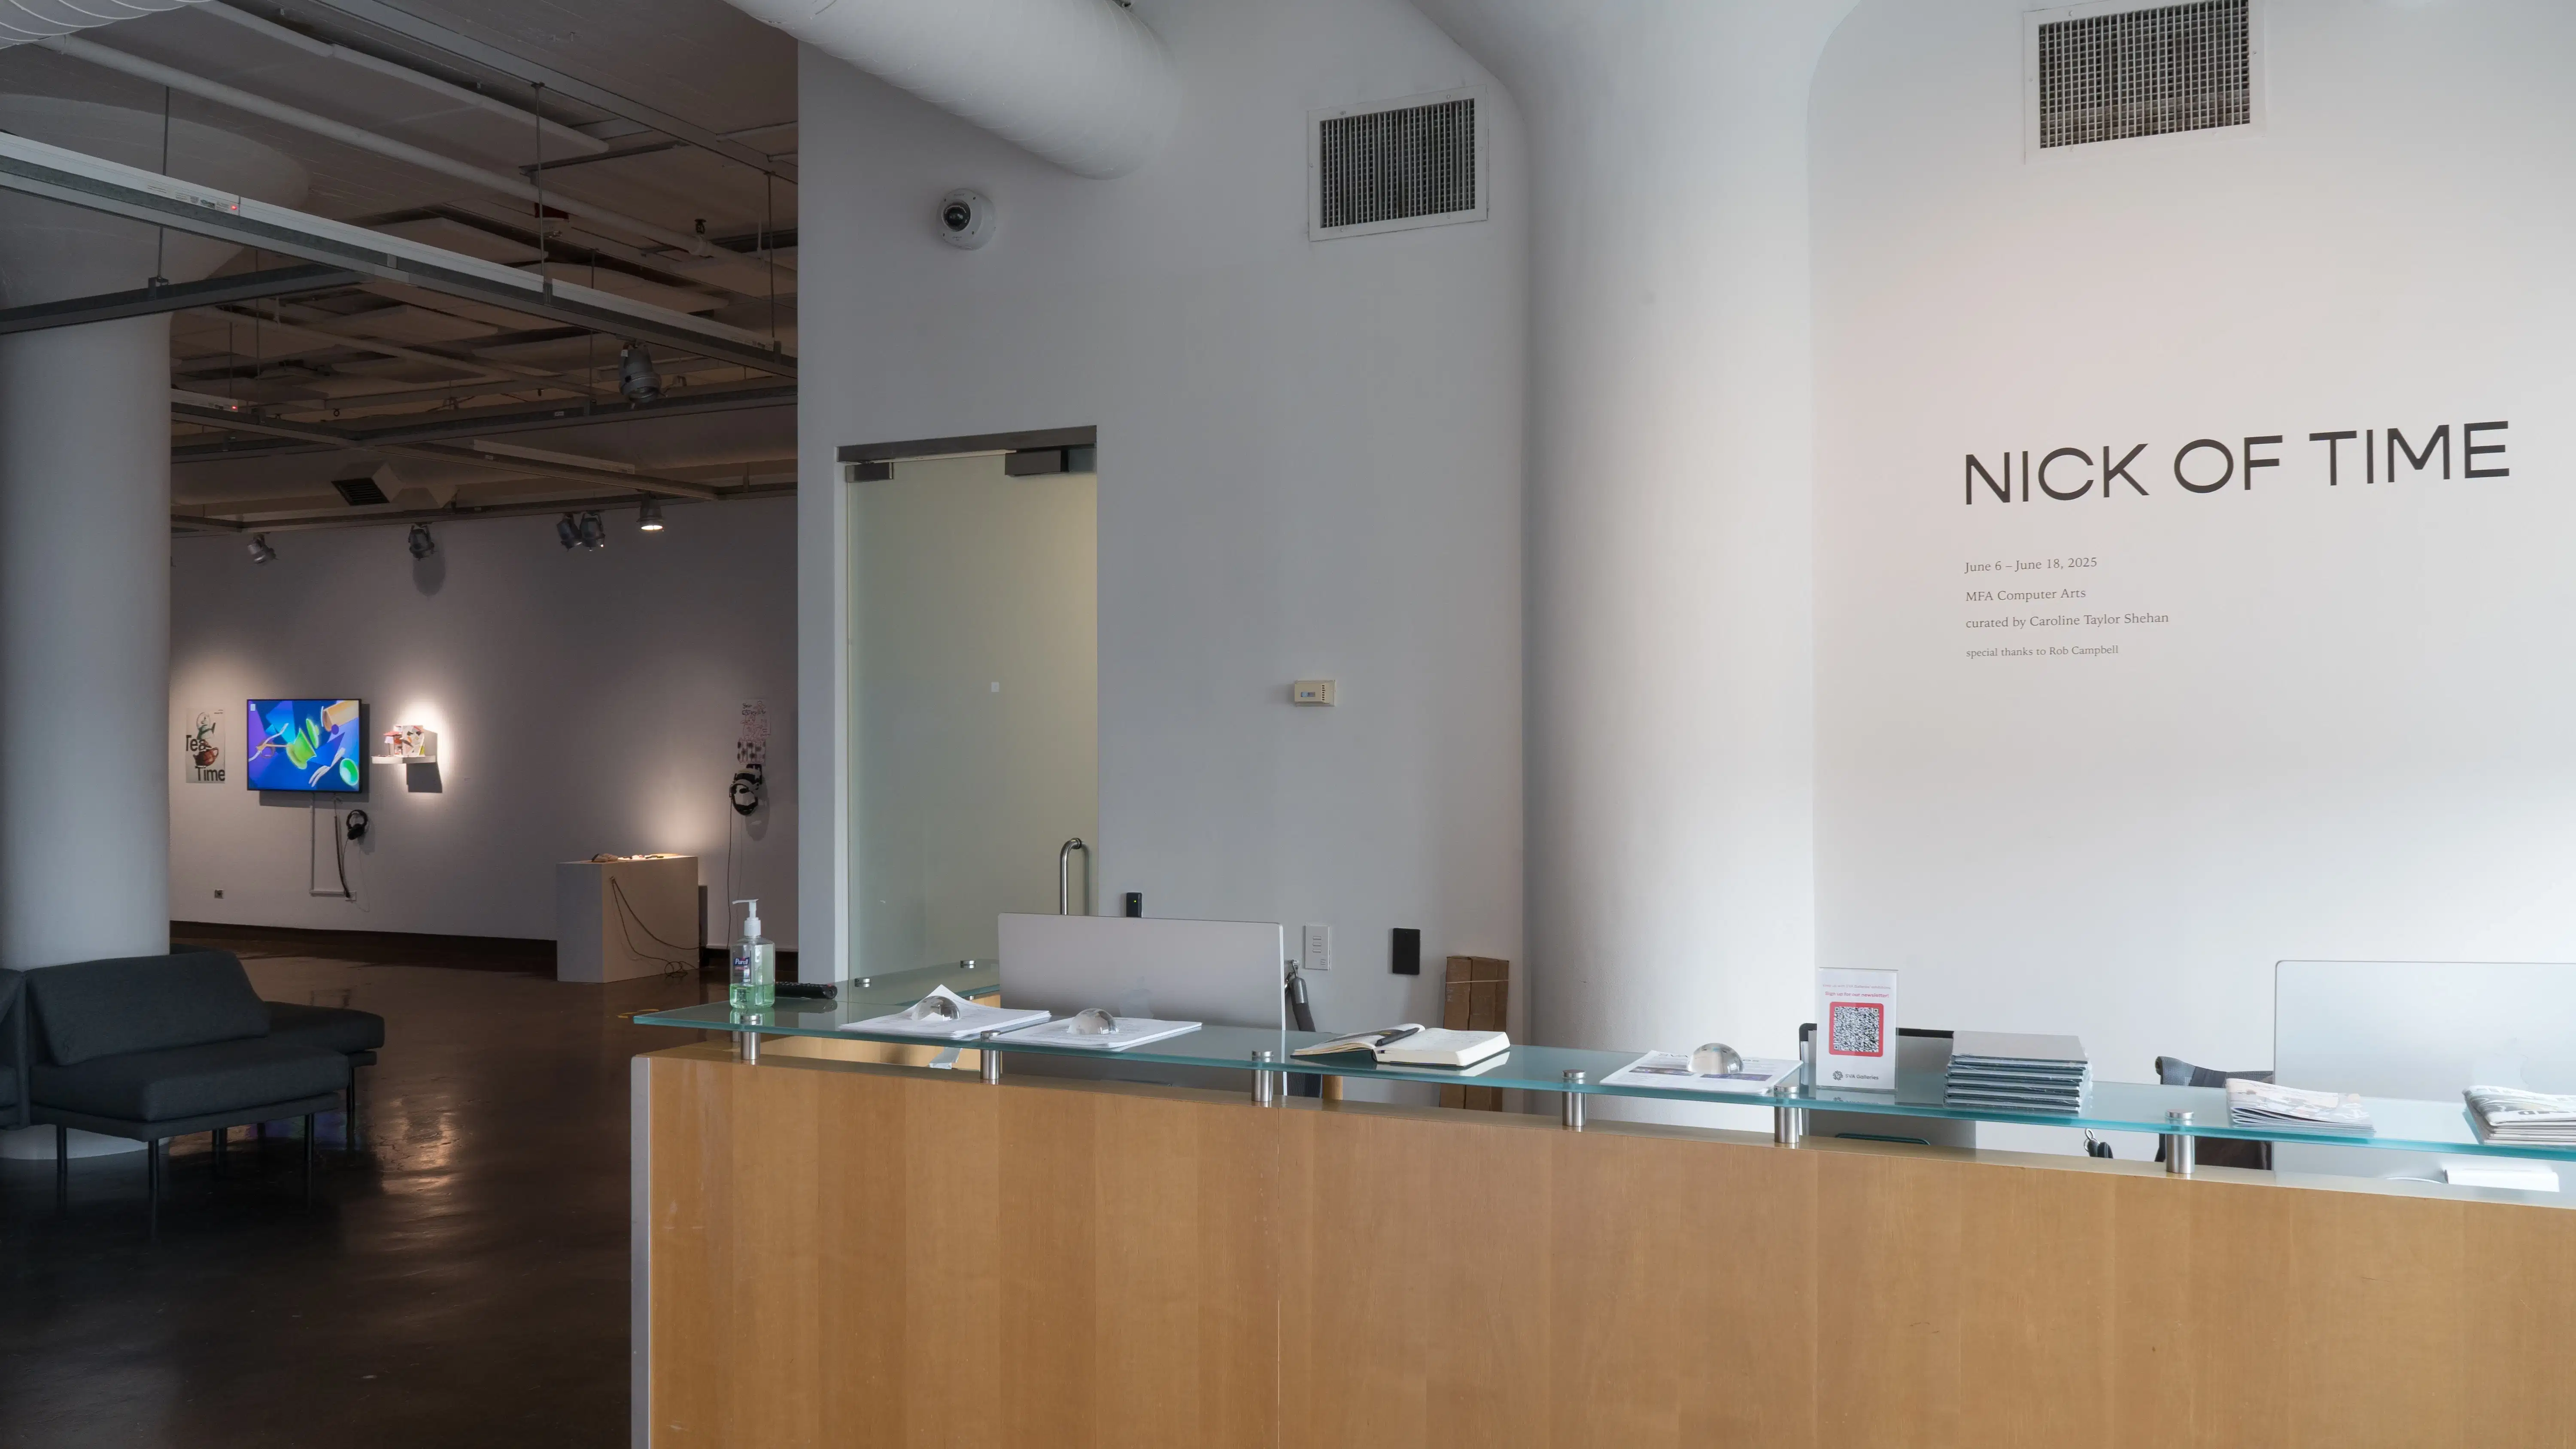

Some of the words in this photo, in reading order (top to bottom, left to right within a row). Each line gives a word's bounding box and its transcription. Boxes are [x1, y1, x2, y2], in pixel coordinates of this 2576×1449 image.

[1965, 444, 2150, 505] NICK
[2174, 435, 2283, 494] OF
[2309, 421, 2510, 486] TIME
[1964, 562, 1991, 574] June
[1995, 561, 2002, 571] 6
[2014, 560, 2042, 572] June
[2047, 558, 2063, 570] 18,
[2067, 557, 2097, 568] 2025
[1965, 591, 1994, 601] MFA
[1998, 590, 2057, 603] Computer
[2060, 588, 2086, 598] Arts
[1966, 617, 2008, 628] curated
[2012, 617, 2026, 630] by
[2030, 615, 2080, 626] Caroline
[2084, 614, 2121, 627] Taylor
[2124, 612, 2169, 624] Shehan
[1966, 648, 1998, 659] special
[2001, 647, 2033, 657] thanks
[2049, 646, 2069, 655] Rob
[2072, 645, 2119, 657] Campbell
[186, 734, 206, 752] Tea
[195, 765, 225, 782] Time
